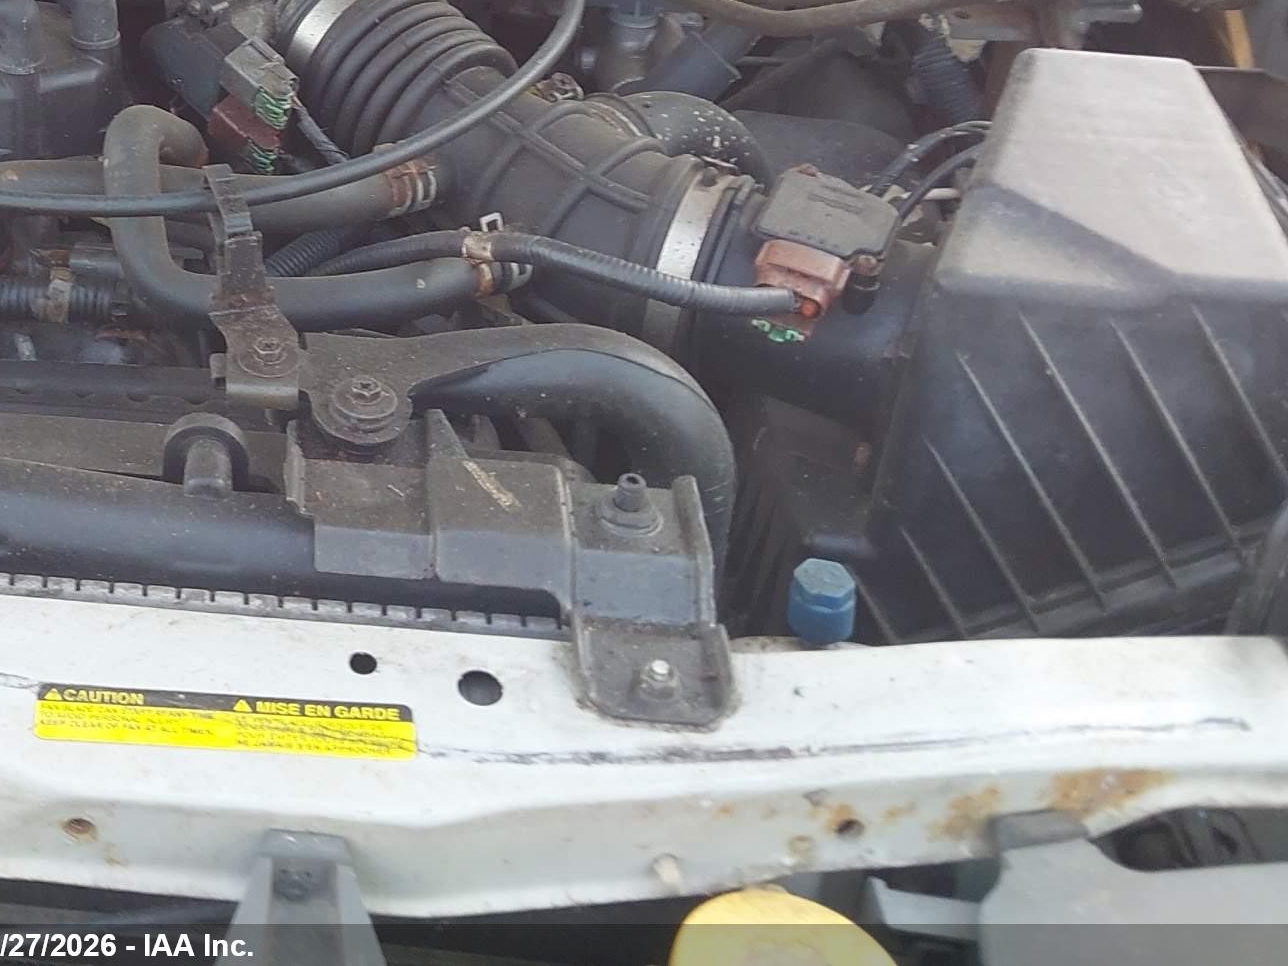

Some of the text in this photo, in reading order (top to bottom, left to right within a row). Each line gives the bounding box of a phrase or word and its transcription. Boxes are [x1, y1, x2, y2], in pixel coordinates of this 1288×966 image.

[62, 688, 144, 705] CAUTION
[255, 700, 401, 721] MISE EN GARDE
